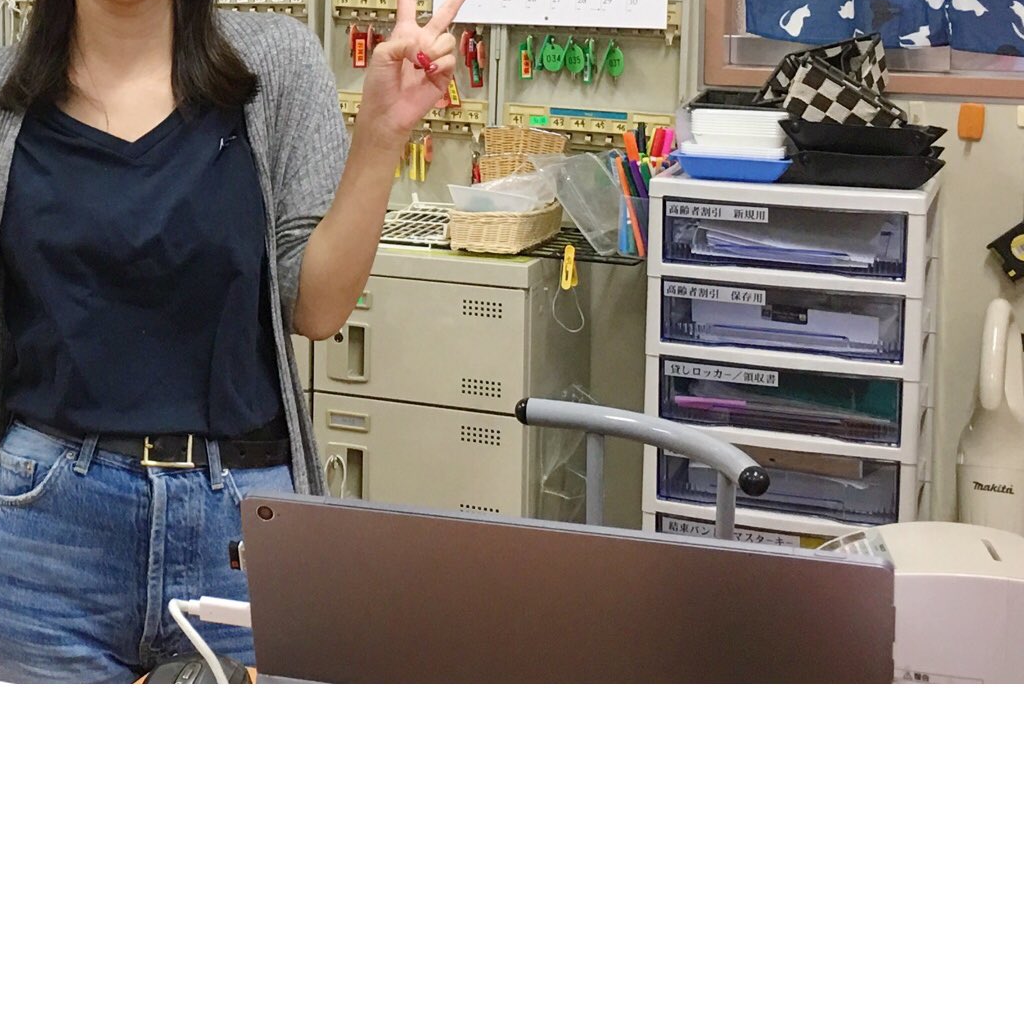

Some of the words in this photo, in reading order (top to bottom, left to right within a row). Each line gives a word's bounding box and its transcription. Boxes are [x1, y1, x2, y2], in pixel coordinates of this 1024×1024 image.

[546, 54, 561, 63] 034
[568, 56, 580, 64] 035
[513, 116, 523, 124] 41
[553, 118, 564, 126] 43
[574, 120, 585, 128] 44
[668, 203, 722, 219] 高齢者割引
[733, 207, 766, 222] 新規用
[666, 283, 719, 299] 高齢者割引
[730, 291, 763, 304] 保存用
